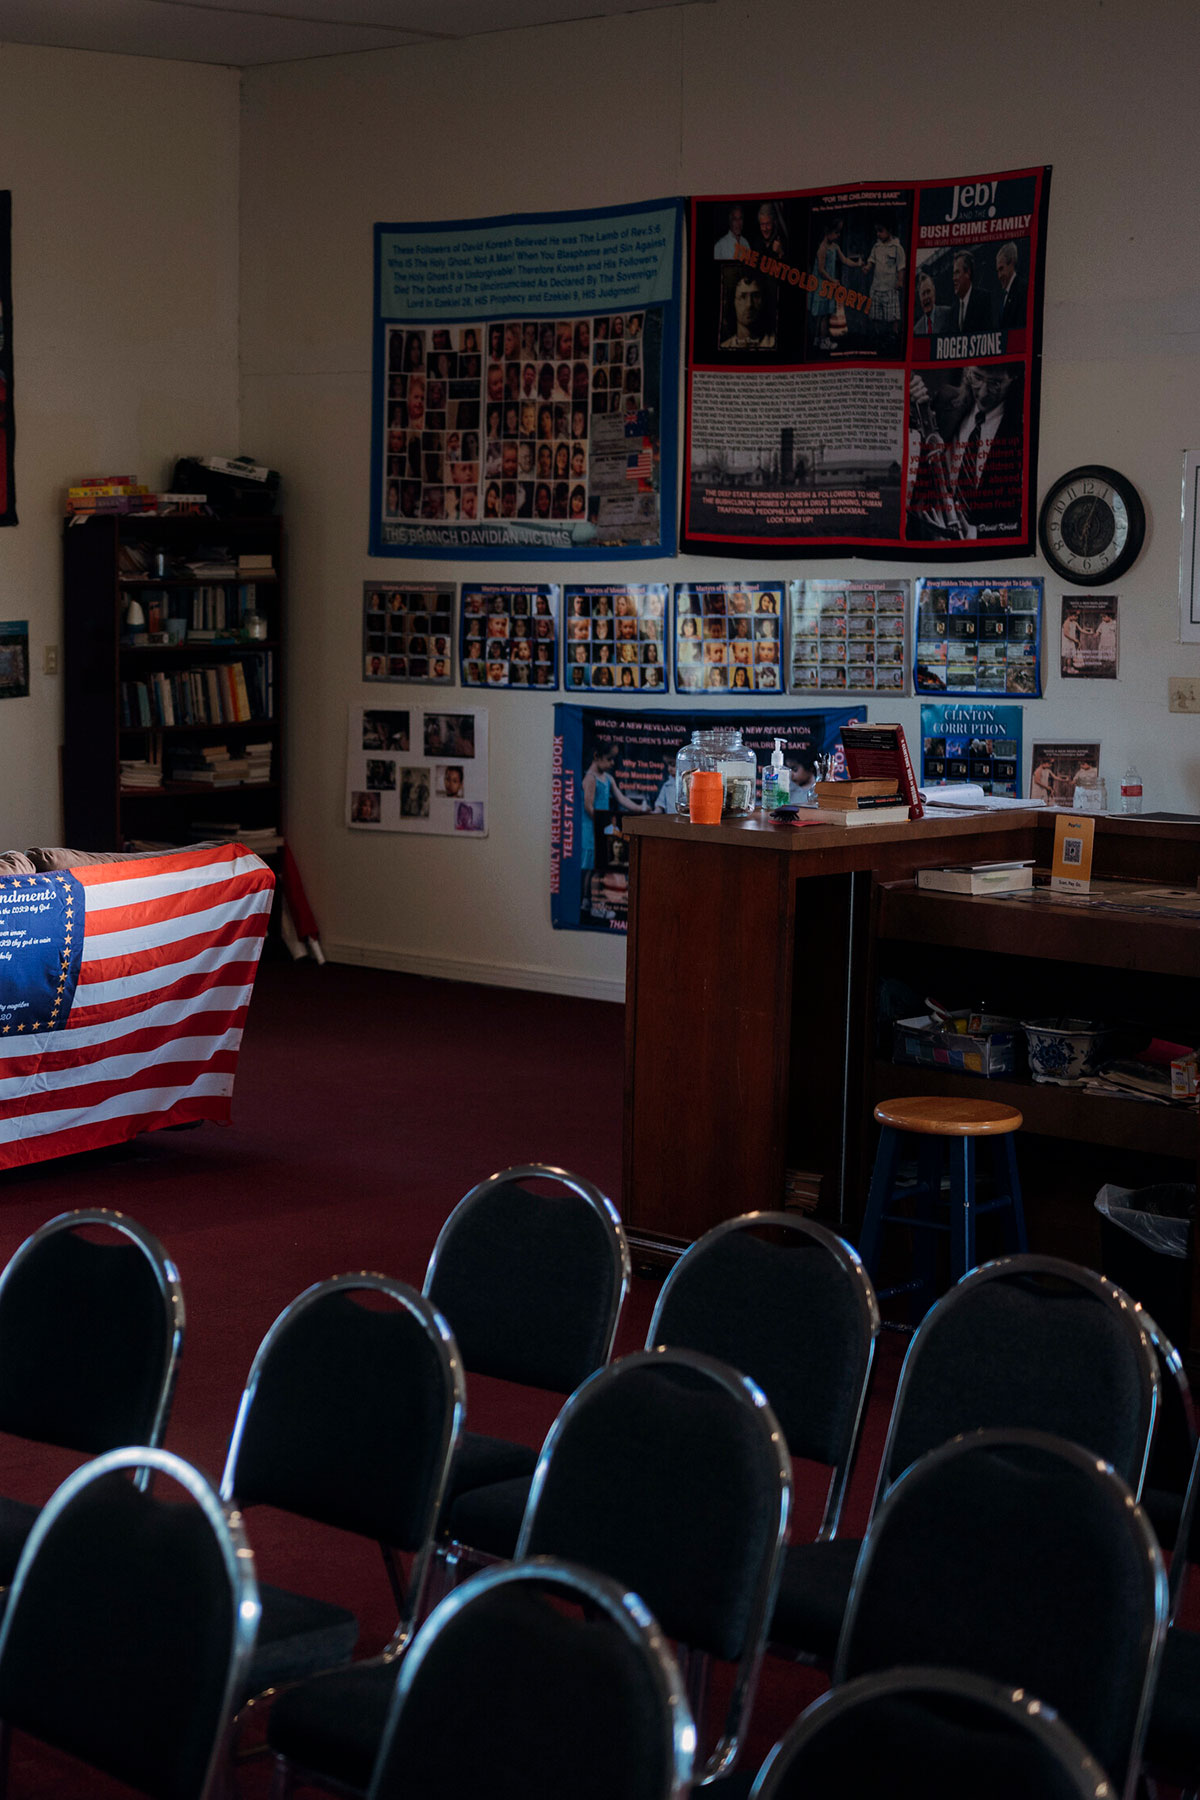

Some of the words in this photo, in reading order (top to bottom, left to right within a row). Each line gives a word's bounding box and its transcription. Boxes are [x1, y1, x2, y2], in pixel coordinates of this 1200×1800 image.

[945, 181, 998, 222] Jeb!
[920, 224, 950, 239] BUSH
[952, 220, 989, 237] CRIME
[990, 215, 1032, 233] FAMILY
[759, 255, 819, 292] UNTOLD
[819, 280, 872, 315] STORY!
[936, 336, 968, 360] ROGER
[969, 332, 1002, 357] STONE
[1066, 488, 1077, 500] 11
[1083, 482, 1095, 494] 12
[1102, 488, 1109, 499] 1
[1054, 500, 1066, 514] 10
[1050, 522, 1060, 532] 9
[461, 530, 519, 544] DAVIDIAN
[1053, 540, 1064, 552] 8
[1066, 553, 1077, 564] 7
[1083, 559, 1092, 570] 6
[1099, 553, 1109, 565] 5
[944, 709, 995, 721] CLINTON
[626, 722, 642, 730] NEW
[643, 723, 687, 733] REVELATION
[746, 726, 762, 735] NEW
[764, 726, 811, 735] REVELATION
[933, 723, 1007, 735] CORRUPTION
[552, 735, 564, 775] BOOK
[551, 777, 563, 844] RELEASED
[564, 804, 574, 817] IT
[563, 821, 574, 860] TELLS
[550, 845, 561, 894] NEWLY
[0, 1013, 12, 1021] 20
